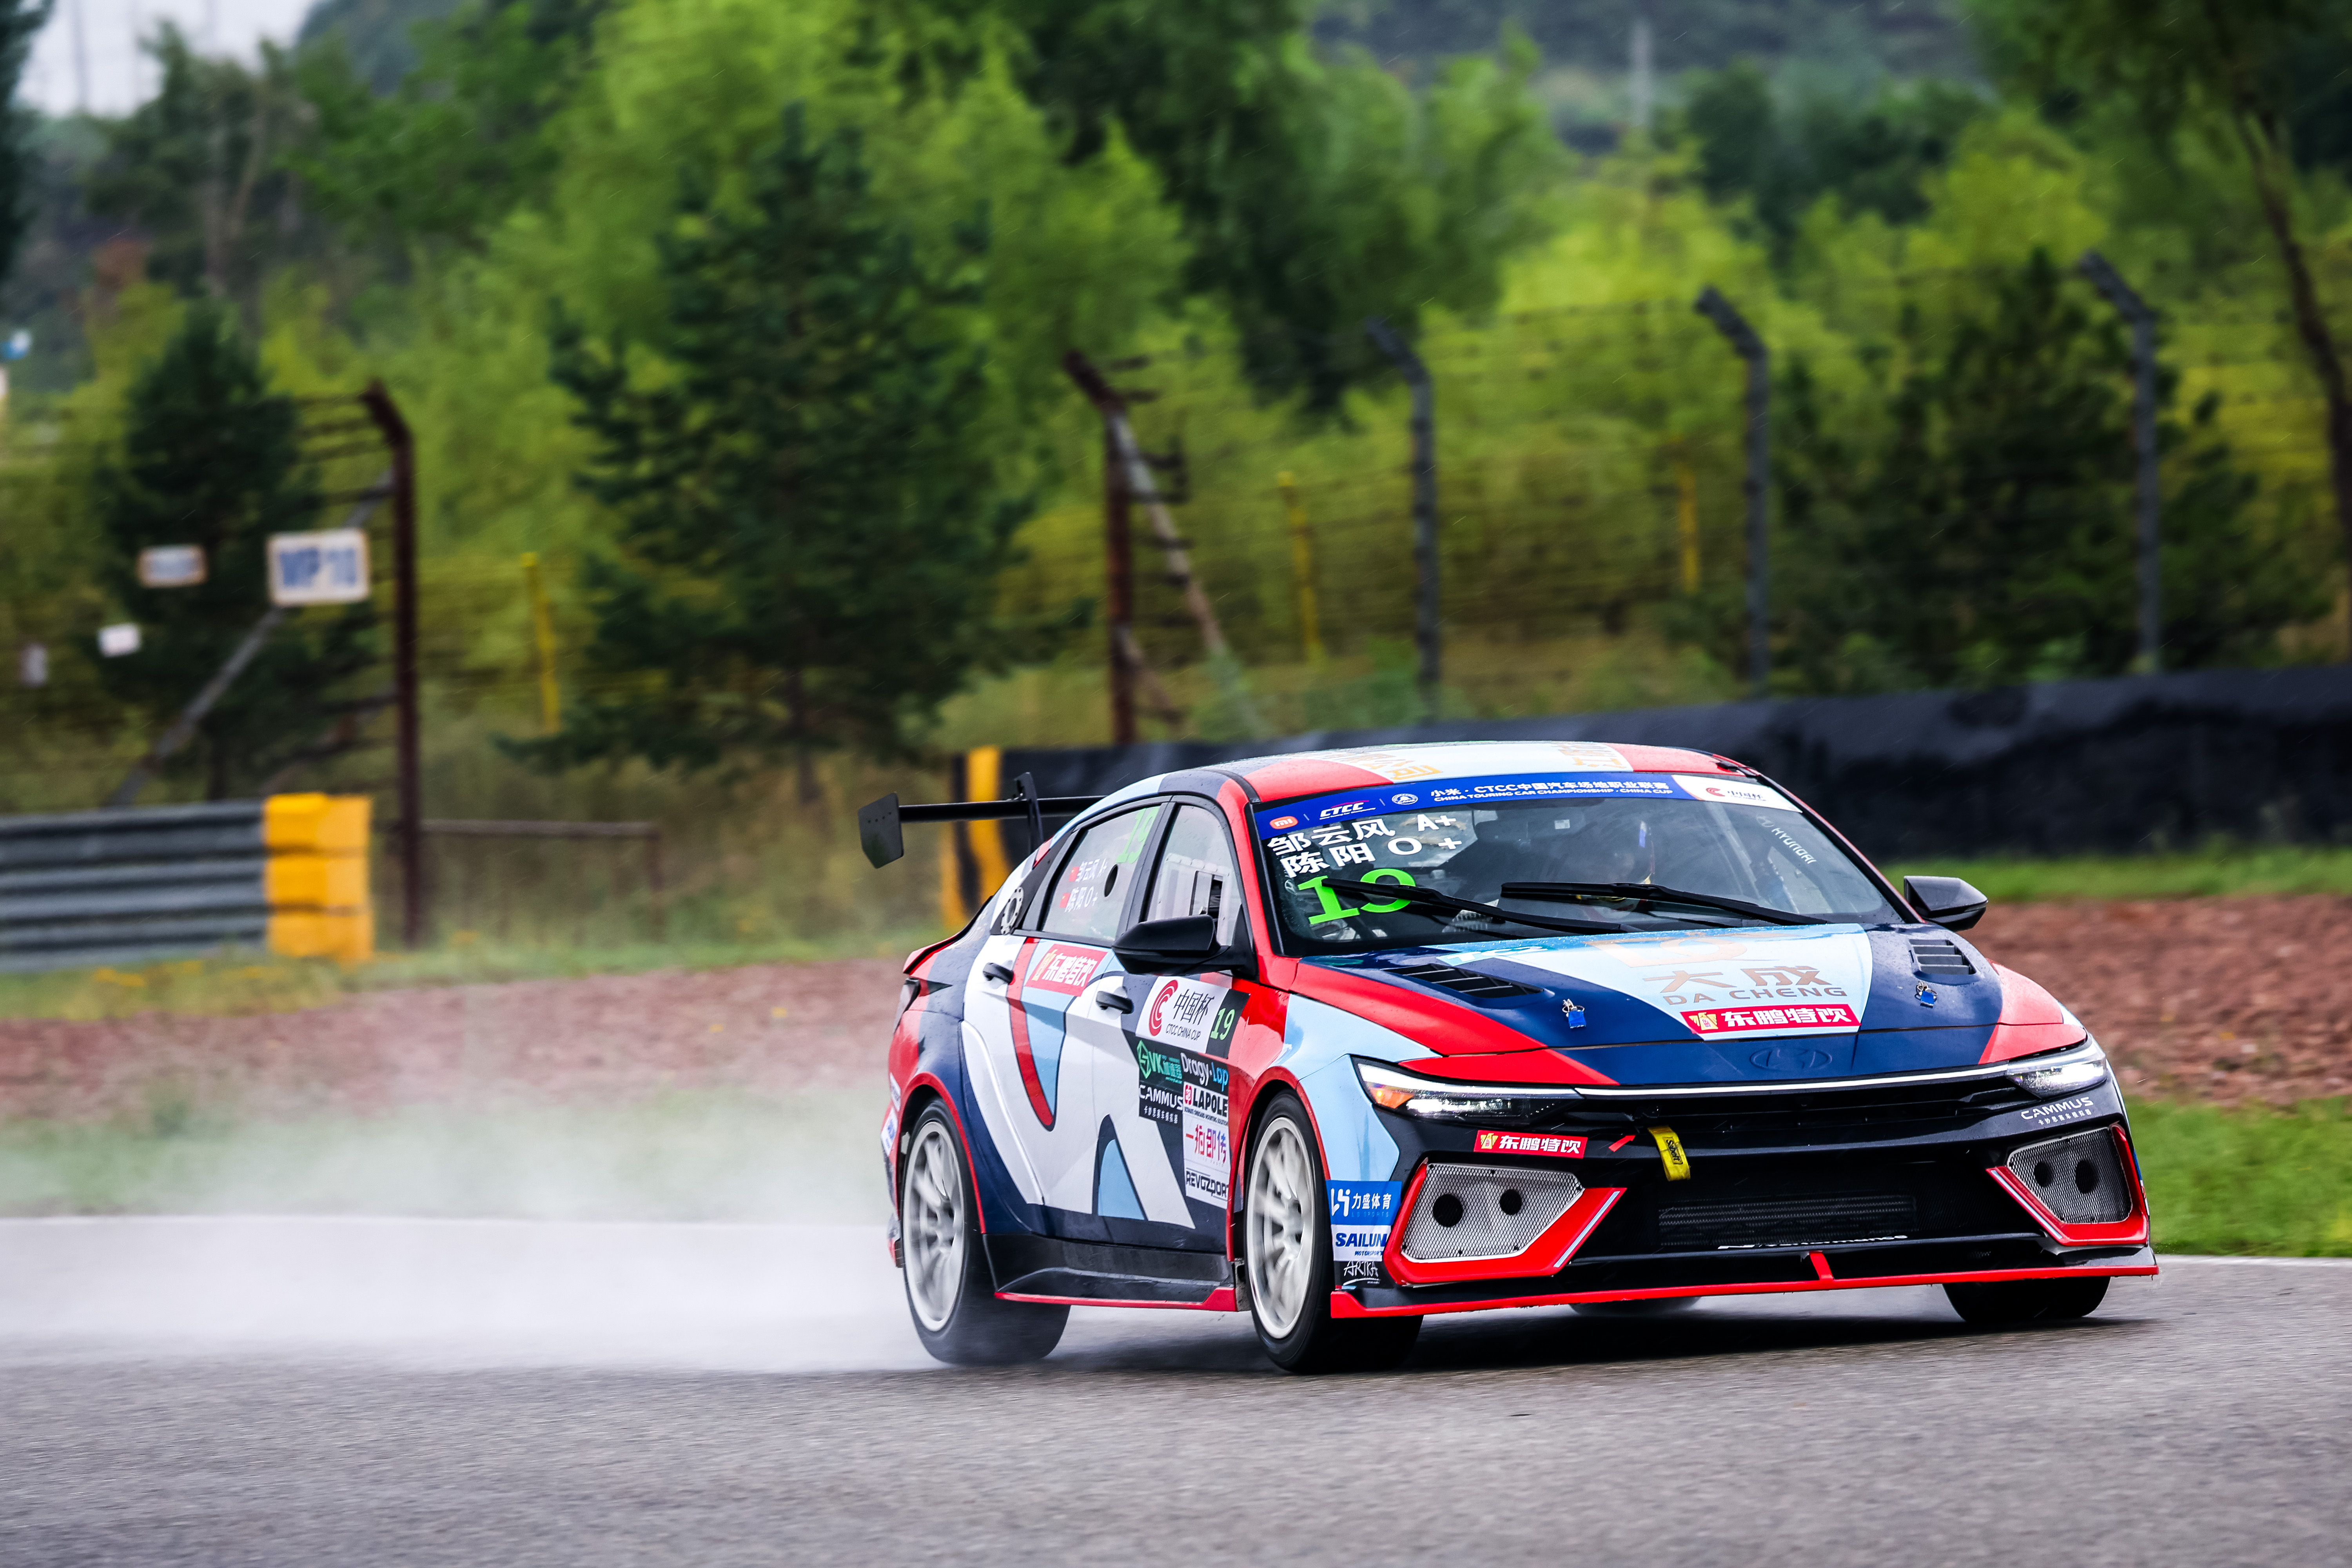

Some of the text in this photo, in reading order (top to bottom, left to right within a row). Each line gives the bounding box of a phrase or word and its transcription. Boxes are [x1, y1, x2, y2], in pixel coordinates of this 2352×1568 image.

[1320, 802, 1364, 817] CTCC
[1116, 807, 1159, 864] 19
[1267, 814, 1456, 856] 邹云风 A+
[1771, 828, 1817, 864] HYUNDAI
[1280, 843, 1376, 878] 陈阳
[1298, 868, 1416, 924] 19
[1042, 953, 1098, 987] 东鹏特饮
[1642, 965, 1832, 993] 大成
[1173, 989, 1215, 1025] 中国杯
[1663, 987, 1847, 1005] DA CHENG
[1210, 1008, 1235, 1041] 19
[1721, 1007, 1852, 1027] 东鹏特饮
[1166, 1023, 1201, 1041] CTCC CHINA CUP
[1139, 1084, 1183, 1111] CAMMUS
[1193, 1088, 1228, 1117] LAPOLE
[2021, 1096, 2094, 1120] CAMMUS
[1186, 1124, 1226, 1164] 一拍即传
[1499, 1135, 1581, 1154] 东鹏特饮
[1351, 1193, 1392, 1210] 力盛体育
[1336, 1233, 1388, 1247] SAILUN
